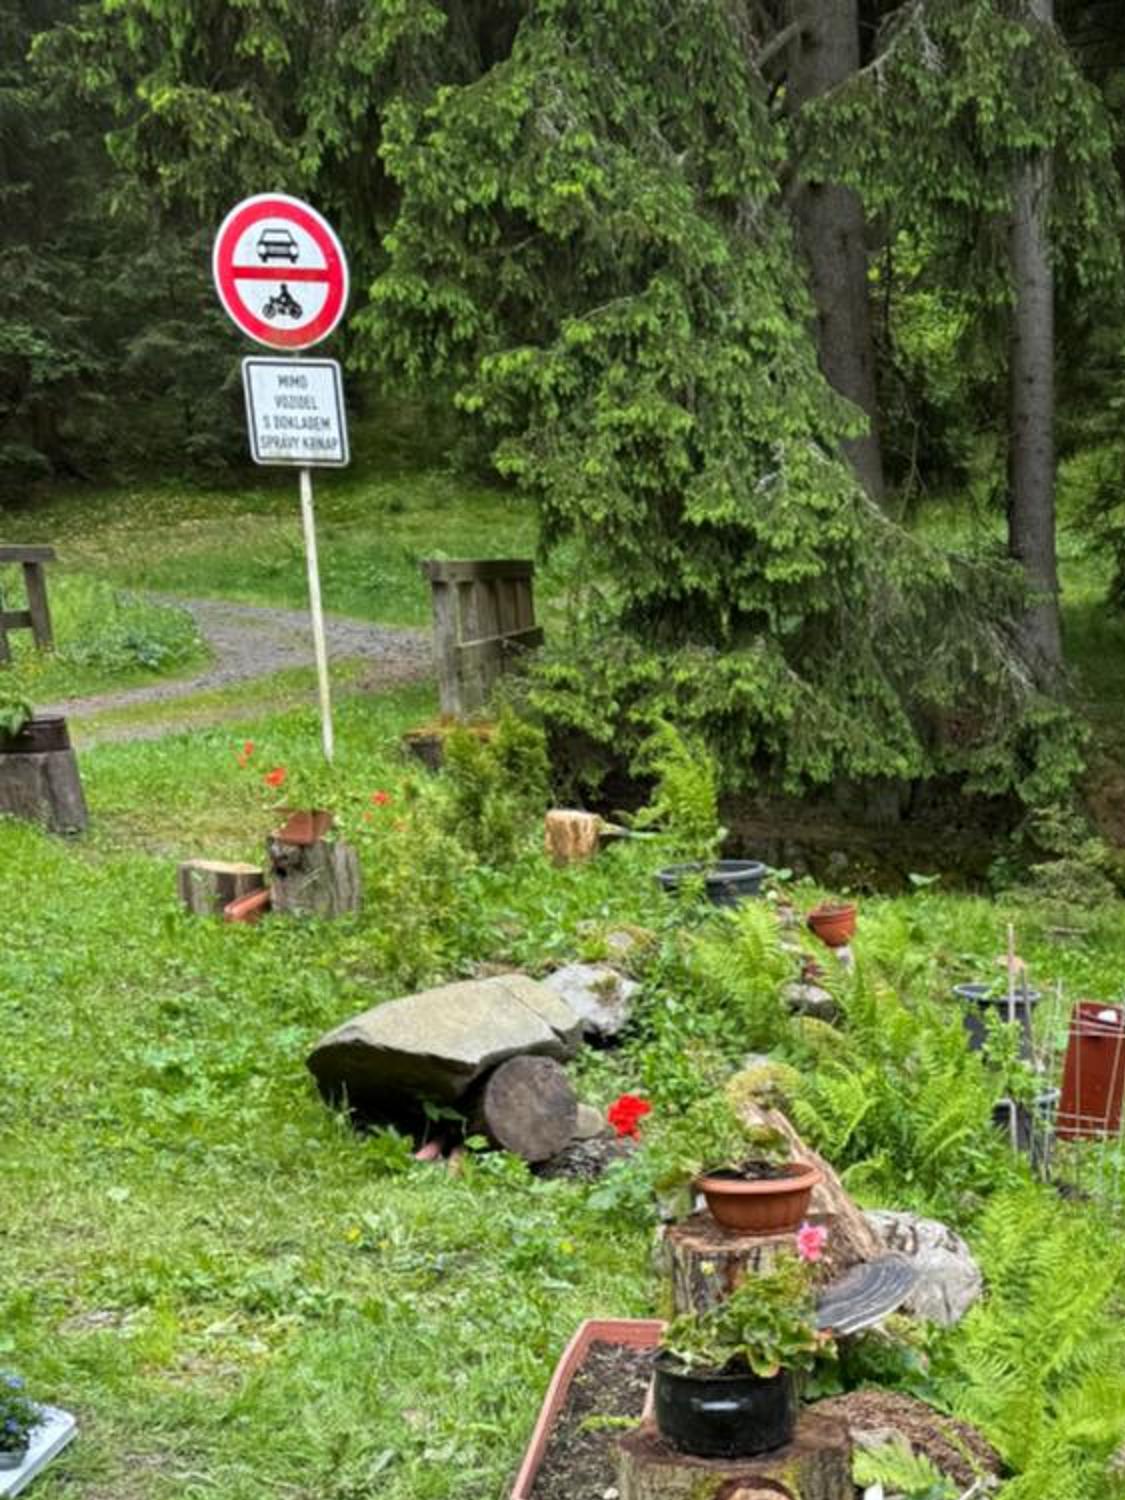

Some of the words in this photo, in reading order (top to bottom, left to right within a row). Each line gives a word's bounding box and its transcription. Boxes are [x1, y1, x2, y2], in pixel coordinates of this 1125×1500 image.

[277, 375, 308, 389] MIMO
[263, 415, 271, 429] S
[274, 415, 331, 430] DOKLADEM
